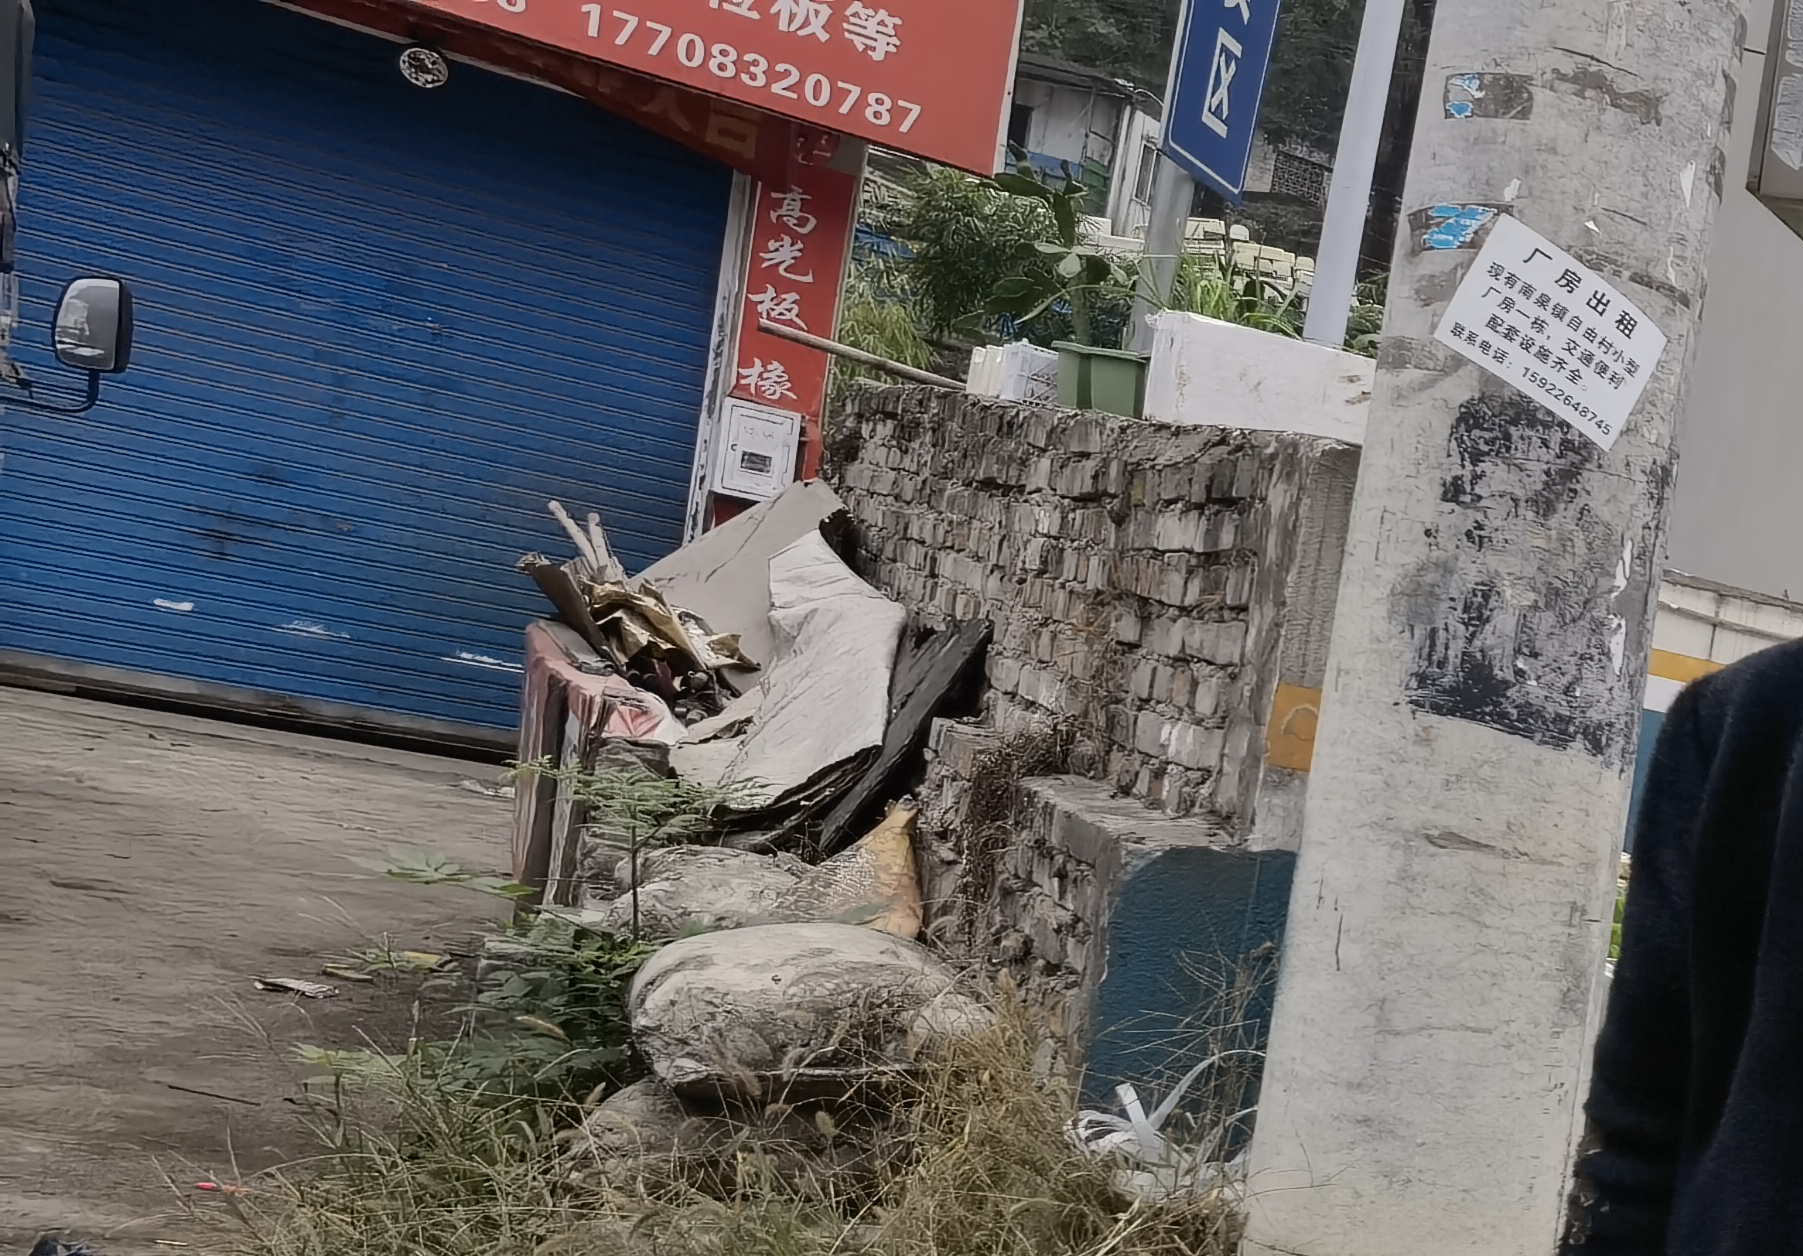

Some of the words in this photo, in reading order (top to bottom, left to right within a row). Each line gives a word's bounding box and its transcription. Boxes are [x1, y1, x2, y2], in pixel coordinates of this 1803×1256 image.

[580, 3, 921, 134] 17708320787
[747, 185, 818, 331] 高光板
[1486, 261, 1641, 378] 现有南泉镇自由村小型
[1522, 247, 1639, 340] 厂房出租
